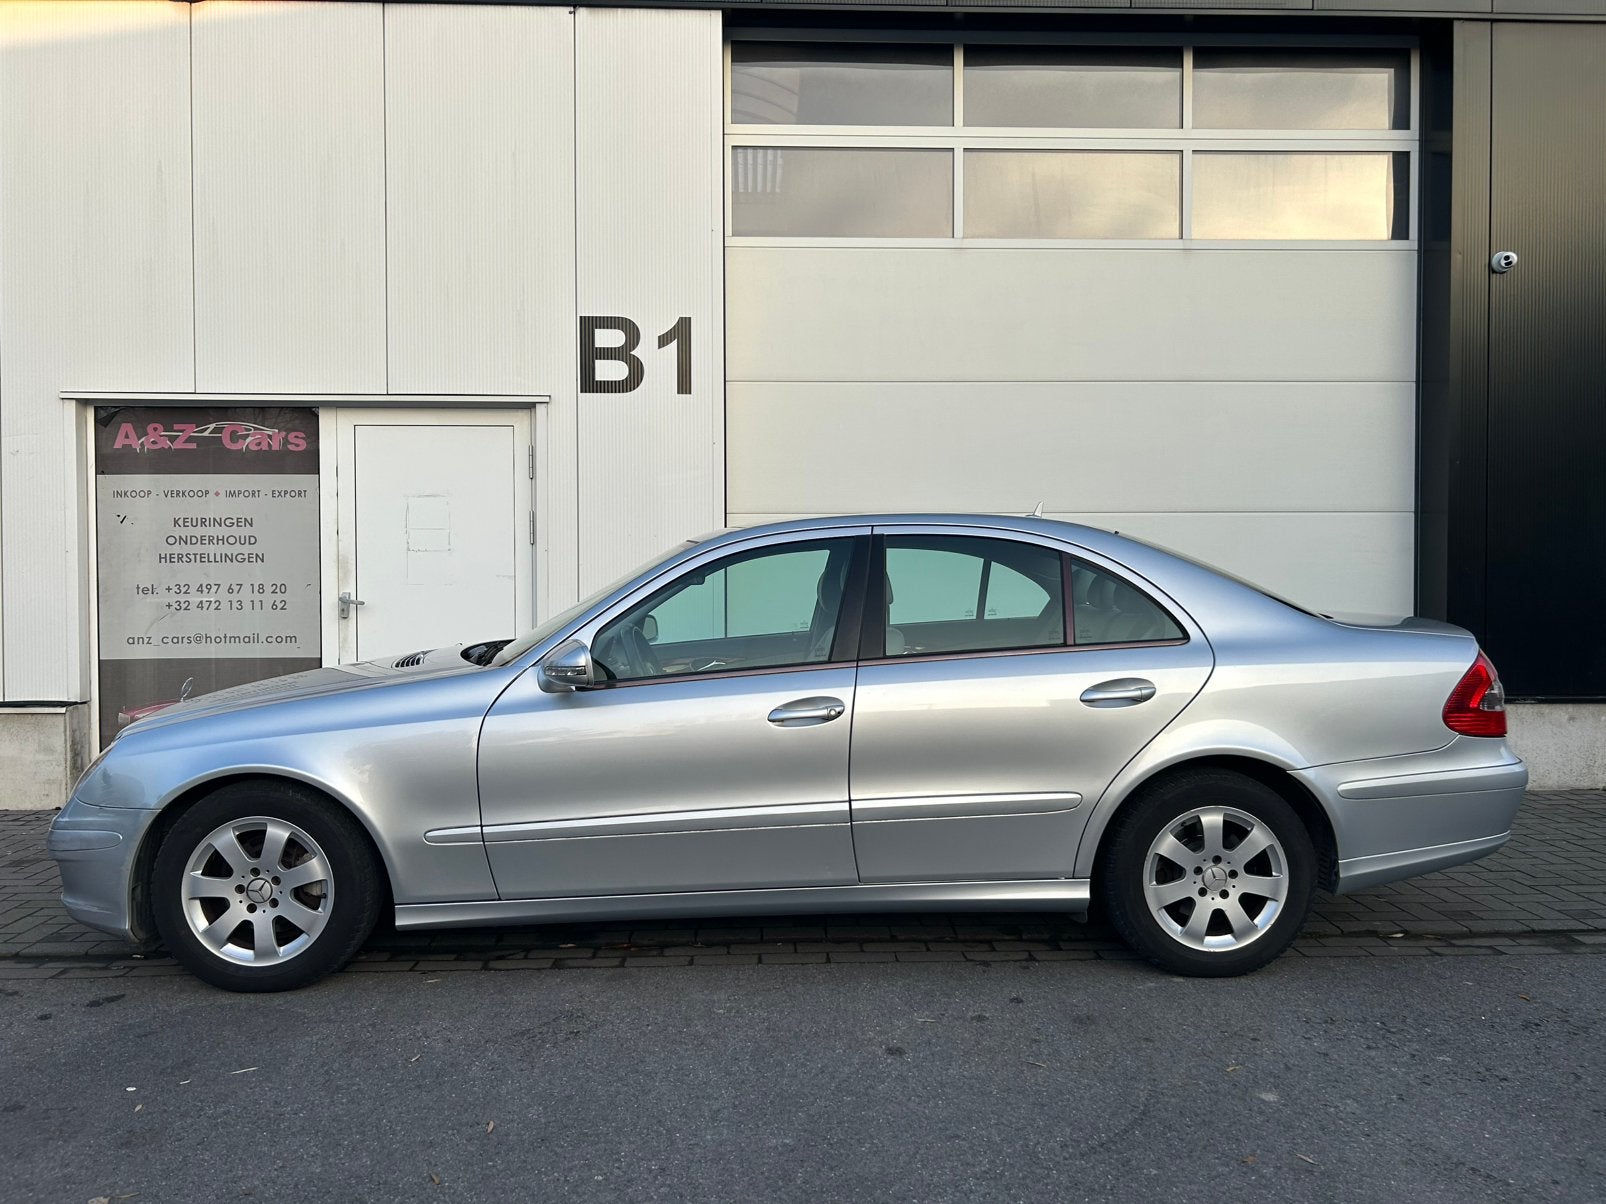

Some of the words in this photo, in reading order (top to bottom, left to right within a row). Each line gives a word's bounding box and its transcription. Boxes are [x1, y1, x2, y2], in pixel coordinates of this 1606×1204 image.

[579, 315, 692, 395] B1
[113, 423, 197, 450] A&Z
[221, 425, 307, 451] Cars
[112, 490, 152, 499] INKOOP
[163, 490, 210, 499] VERKOOP
[225, 490, 261, 499] IMPORT
[271, 490, 307, 499] EXPORT
[173, 517, 253, 528] KEURINGEN
[165, 535, 258, 546] ONDERHOUD
[158, 553, 265, 564] HERSTELLINGEN
[165, 584, 191, 595] +32
[196, 584, 221, 595] 497
[227, 584, 243, 594] 67
[250, 584, 265, 594] 18
[271, 584, 287, 594] 20
[165, 600, 191, 611] +32
[196, 600, 221, 611] 472
[228, 600, 243, 611] 13
[250, 600, 264, 611] 11
[271, 600, 287, 611] 62
[126, 633, 298, 647] anz_cars@hotmail.com
